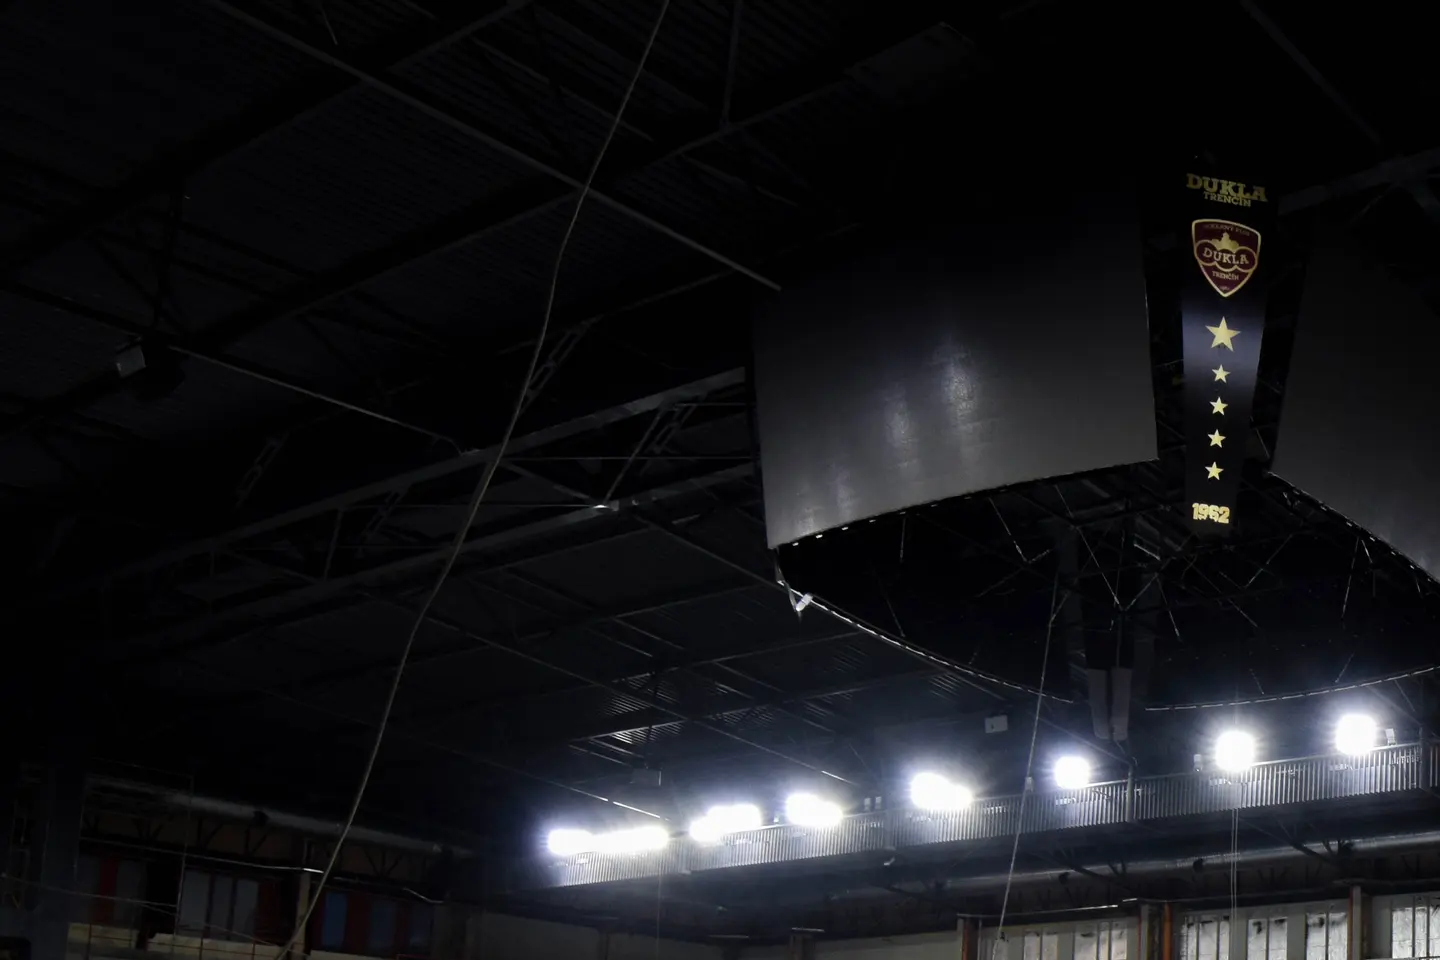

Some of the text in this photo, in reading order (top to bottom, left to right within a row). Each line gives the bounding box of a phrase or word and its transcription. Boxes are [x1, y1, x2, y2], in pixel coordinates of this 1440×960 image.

[1186, 172, 1268, 202] DUKLA
[1203, 247, 1250, 265] DUKLA
[1192, 502, 1230, 524] 1962
